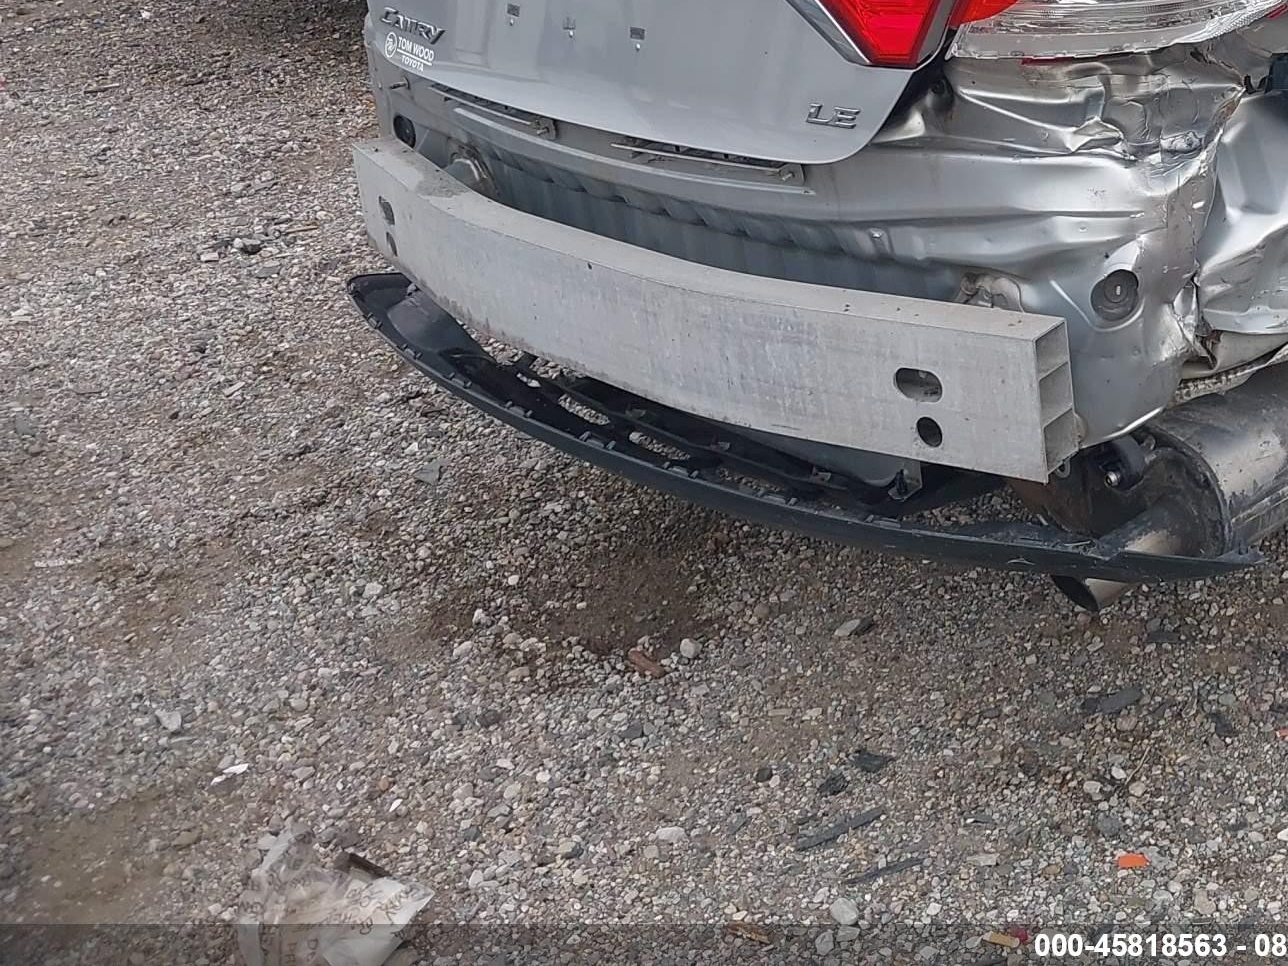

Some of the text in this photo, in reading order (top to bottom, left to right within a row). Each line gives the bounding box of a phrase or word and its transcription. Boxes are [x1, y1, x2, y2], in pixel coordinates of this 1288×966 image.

[381, 7, 446, 45] CAMRY
[398, 36, 412, 52] TOM
[413, 42, 435, 62] WOOD
[401, 55, 424, 72] TOYOTA
[806, 103, 860, 129] LE
